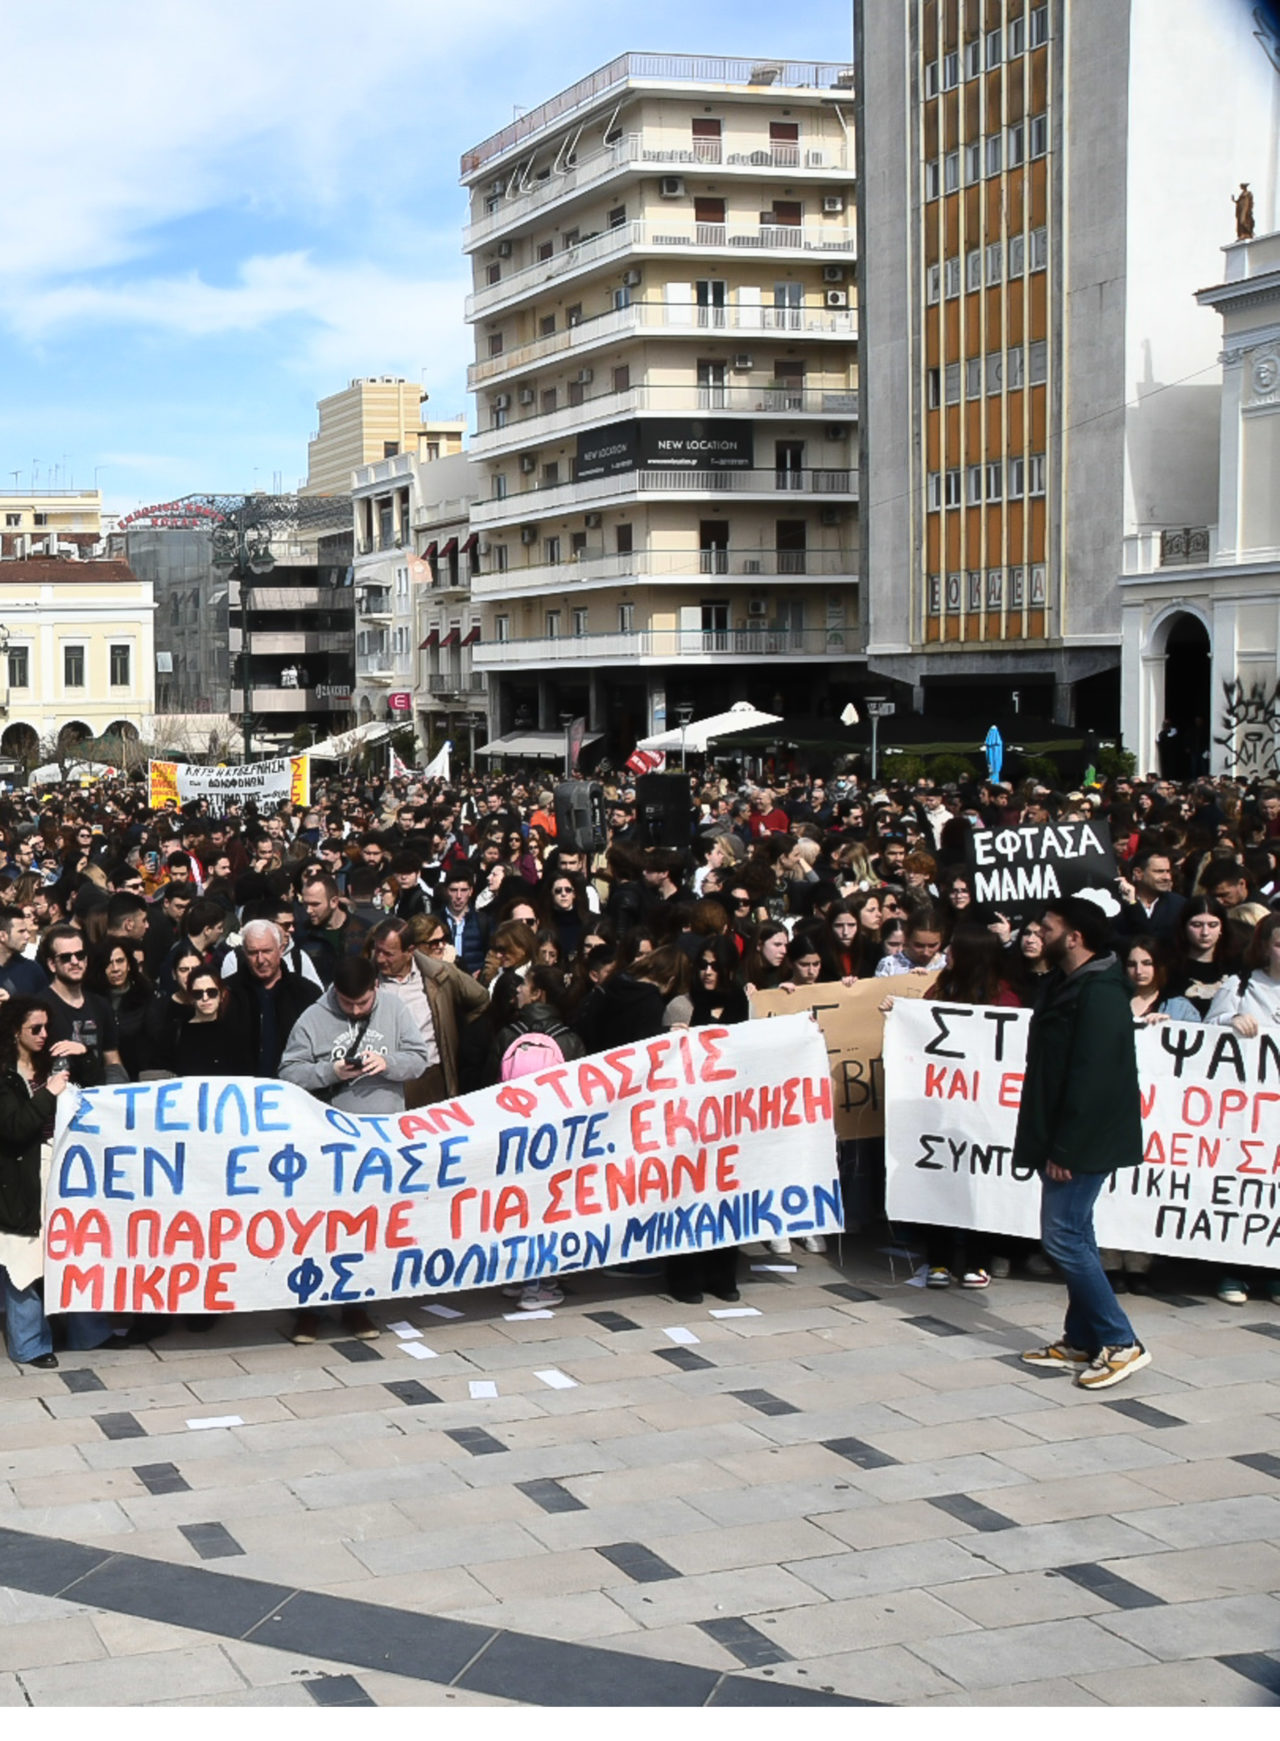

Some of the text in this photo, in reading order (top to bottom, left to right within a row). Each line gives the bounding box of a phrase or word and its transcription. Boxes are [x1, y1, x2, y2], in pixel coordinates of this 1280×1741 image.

[658, 440, 737, 450] NEW LOCATION
[973, 824, 1105, 865] ΕΦΤΑΣΑ
[974, 864, 1061, 903] ΜΑΜΑ
[68, 1028, 737, 1143] ΣΤΕΙΛΕ ΟΤΑΝ ΦΤΑΣΕΙΣ
[925, 1064, 979, 1102] ΚΑΙ
[59, 1077, 832, 1199] ΔΕΝ ΕΦΤΑΣΕ ΠΟΤΕ. ΕΚΔΙΚΗΣΗ
[1144, 1131, 1220, 1168] ΔΕΝ
[47, 1206, 112, 1260] ΘΑ
[128, 1200, 418, 1260] ΠΑΡΟΥΜΕ
[451, 1185, 529, 1240] ΓΙΑ
[60, 1262, 237, 1312] ΜΙΚΡΕ
[391, 1223, 610, 1287] ΠΟΛΙΤΙΚΩΝ
[621, 1179, 844, 1258] ΜΗΧΑΝΙΚΩΝ
